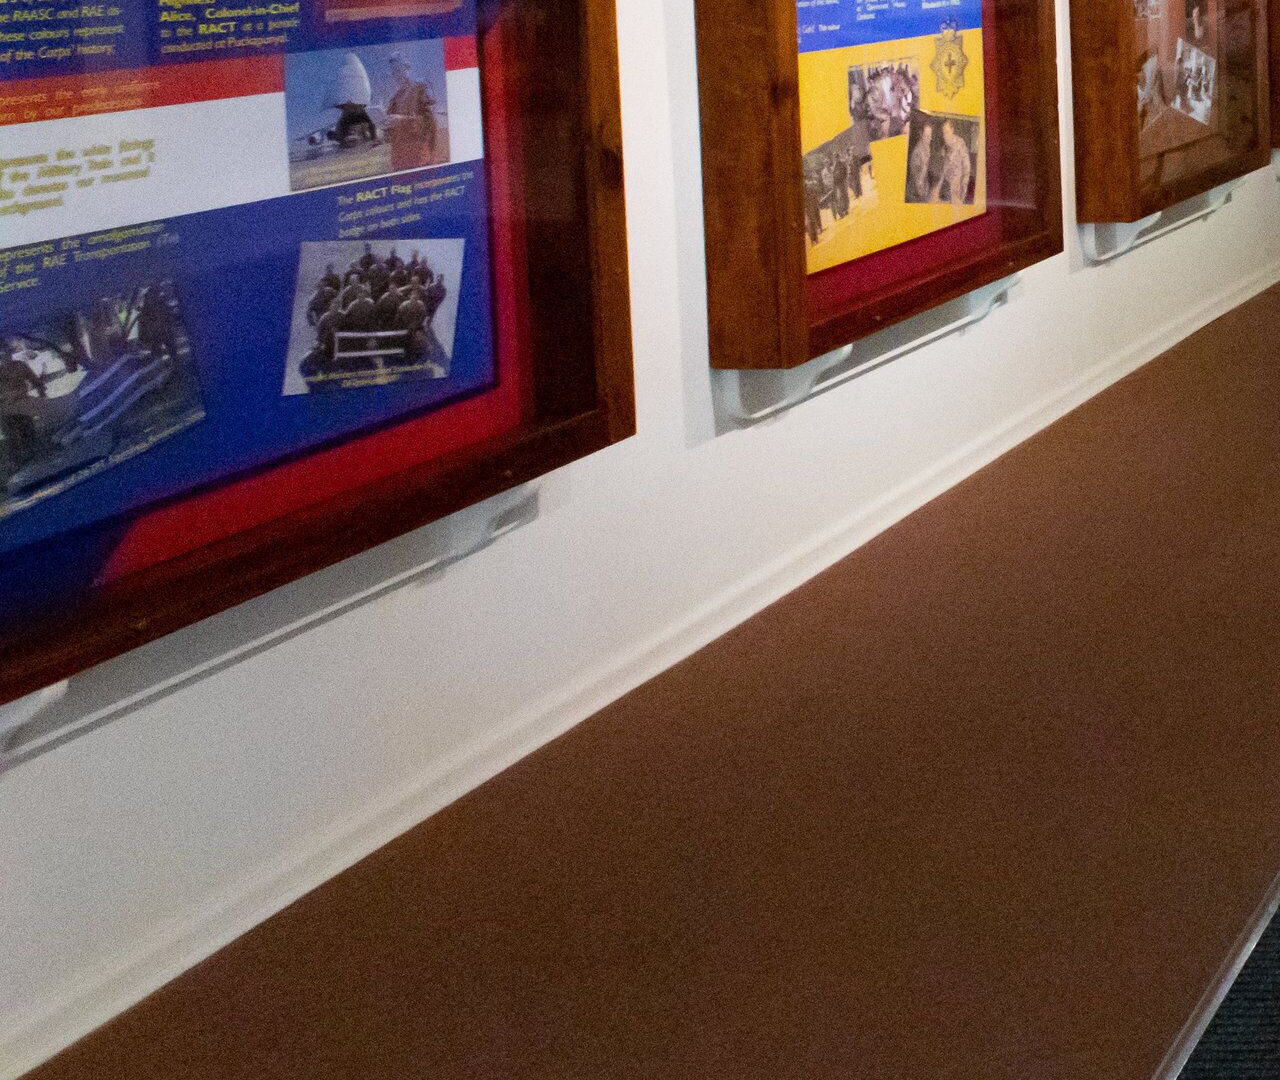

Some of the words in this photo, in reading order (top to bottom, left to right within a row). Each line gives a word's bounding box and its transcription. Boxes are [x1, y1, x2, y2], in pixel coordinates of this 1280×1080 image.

[12, 7, 54, 21] RAASC
[57, 7, 79, 19] and
[205, 3, 299, 19] Colonel-in-Chief
[198, 21, 237, 34] RACT
[0, 31, 25, 42] hese
[356, 186, 388, 203] RACT
[390, 184, 413, 196] Flag
